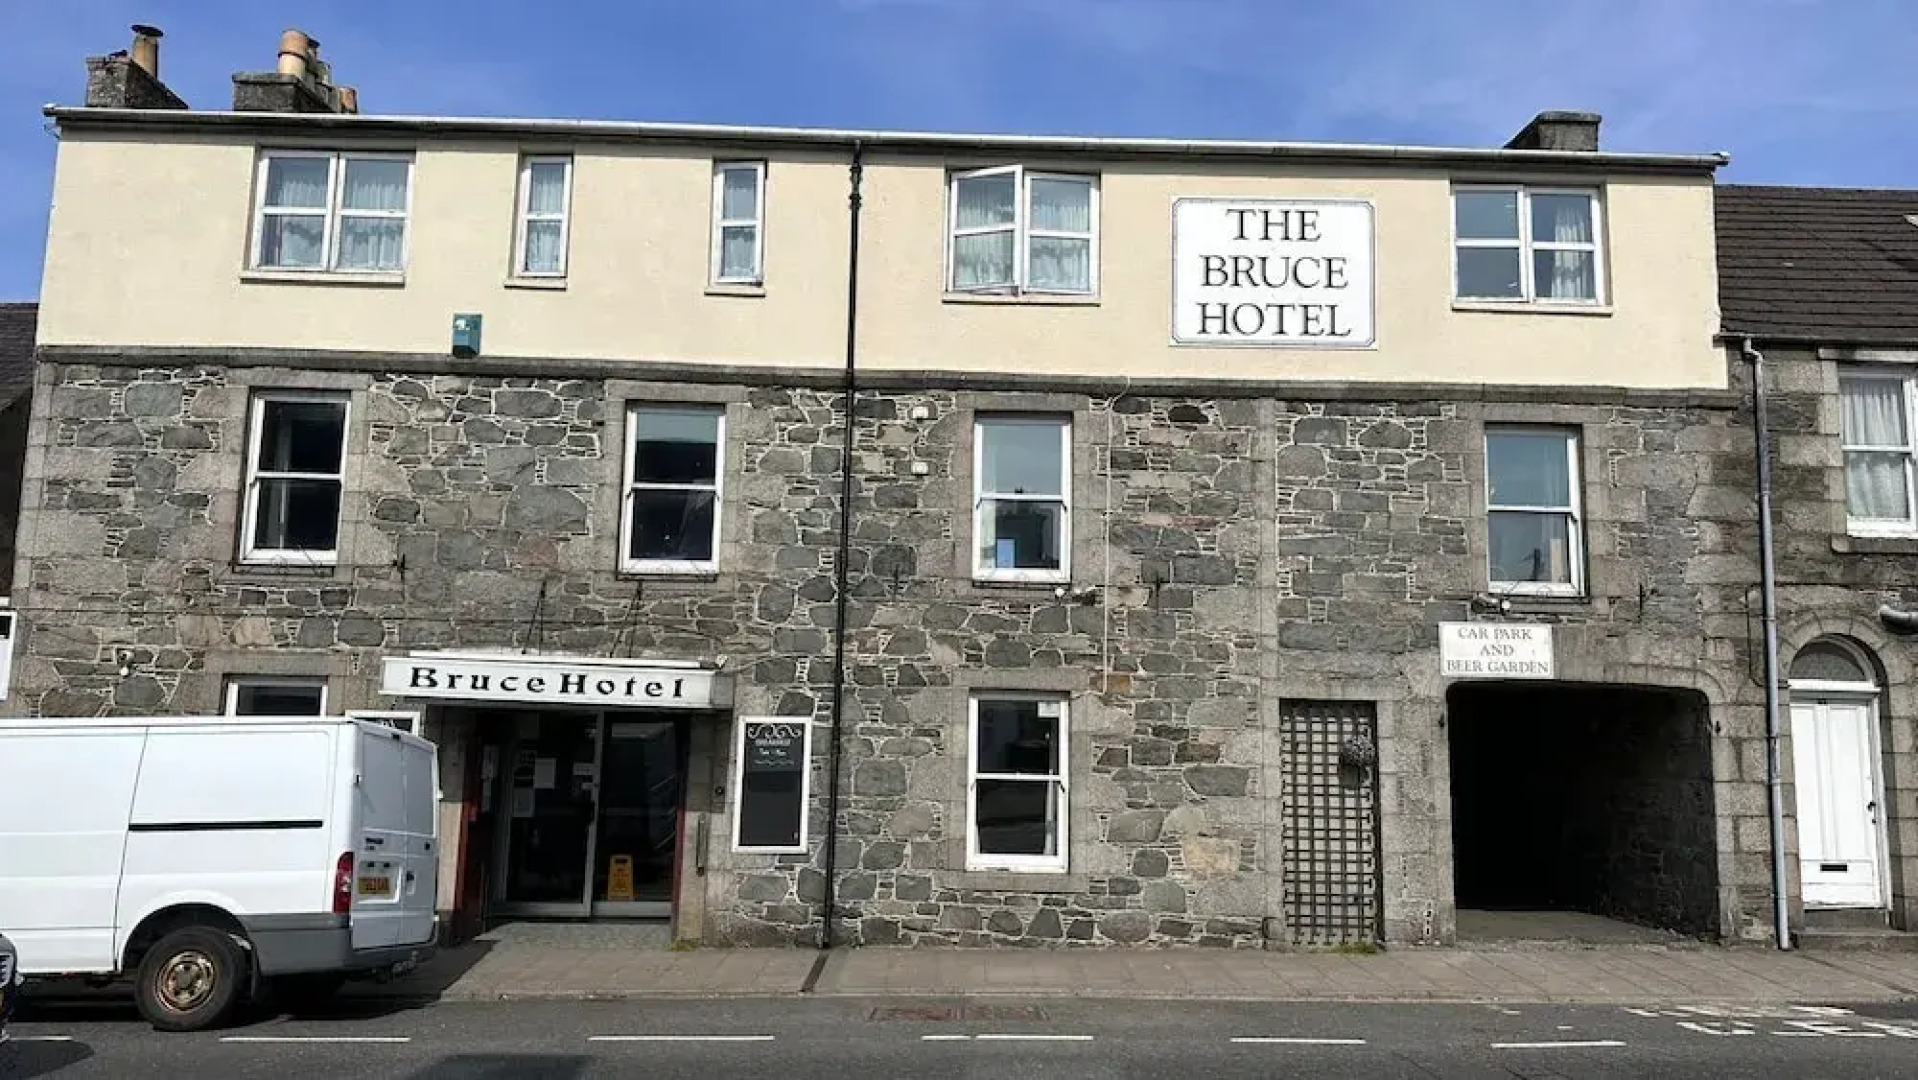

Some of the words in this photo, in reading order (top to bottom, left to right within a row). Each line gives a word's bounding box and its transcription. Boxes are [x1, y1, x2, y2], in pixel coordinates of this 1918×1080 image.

[1226, 208, 1322, 242] THE
[1199, 254, 1349, 289] BRUCE
[1196, 302, 1351, 337] HOTEL
[1458, 627, 1489, 640] CAR
[1493, 627, 1533, 640] PARK
[1480, 643, 1515, 657] AND
[409, 666, 547, 694] Bruce
[558, 672, 684, 698] Hotel
[1446, 659, 1483, 673] BEER
[1487, 661, 1549, 674] GARDEN
